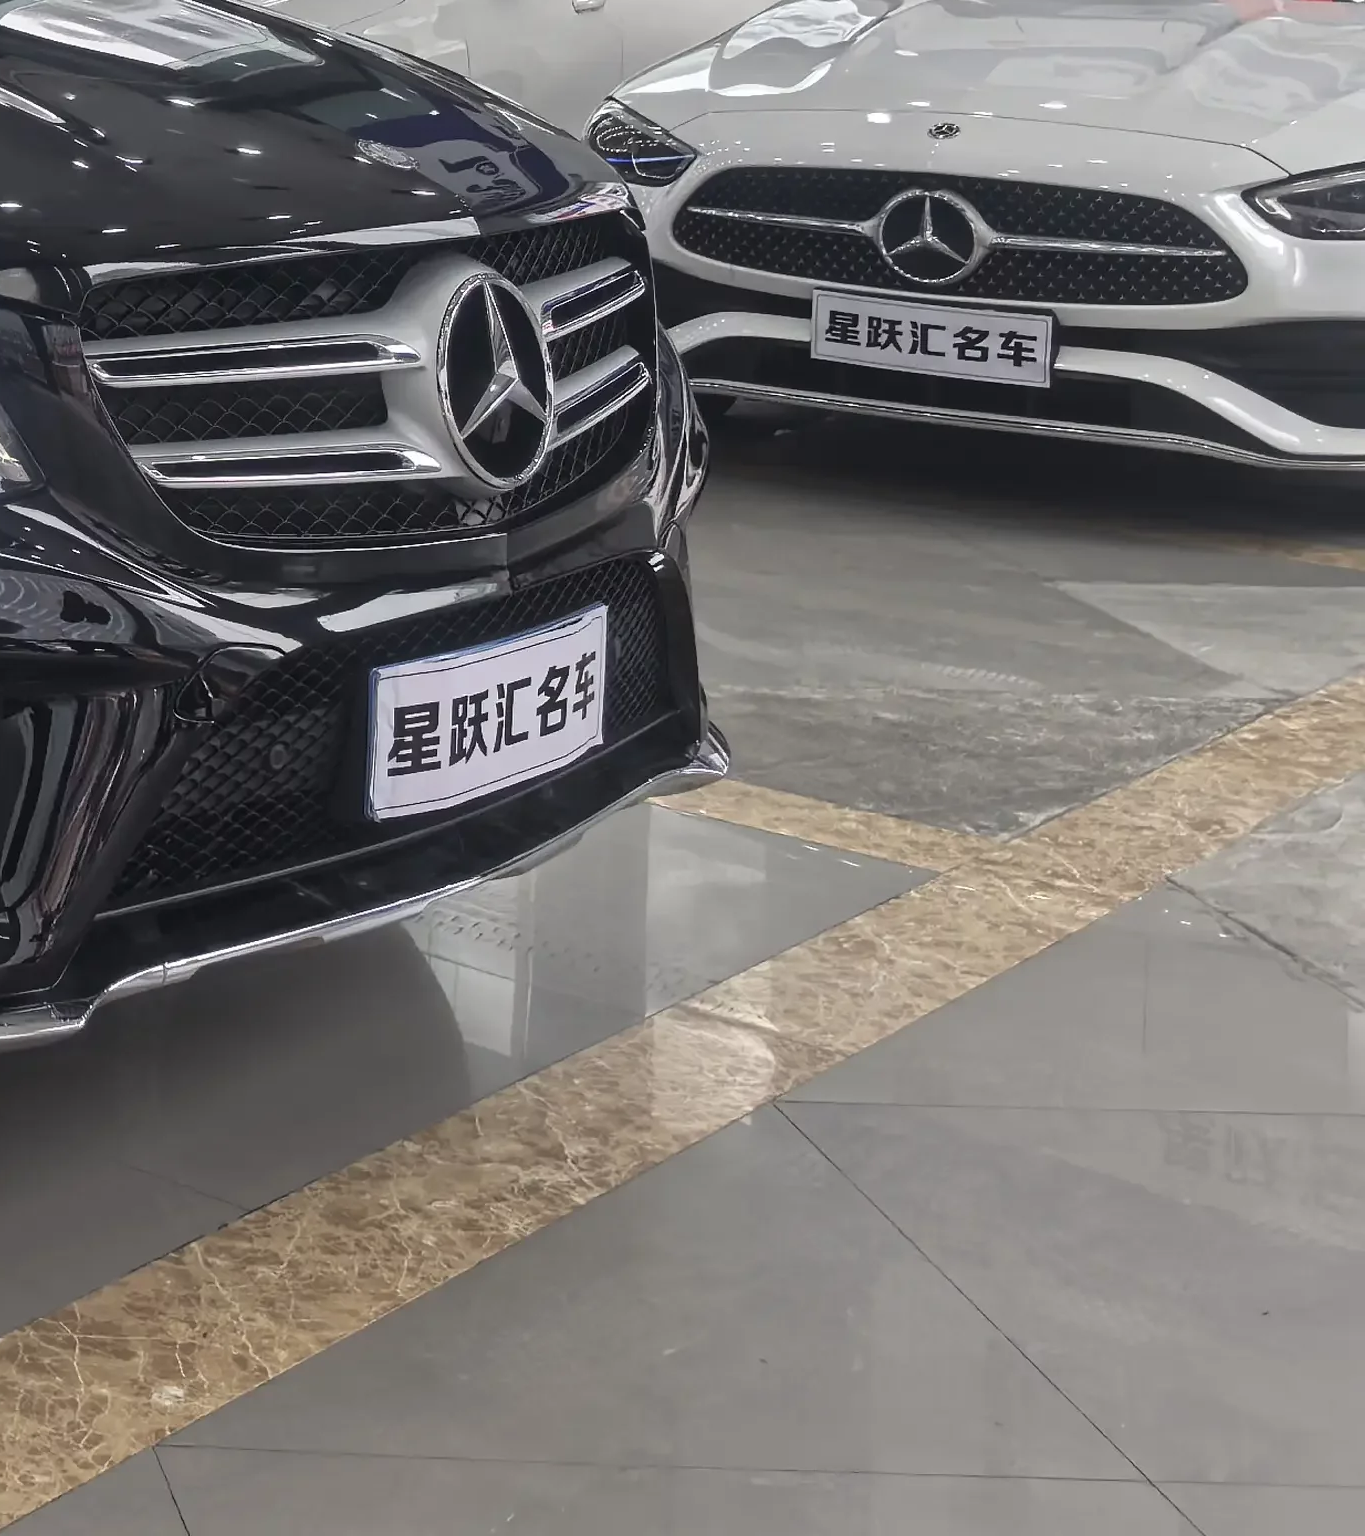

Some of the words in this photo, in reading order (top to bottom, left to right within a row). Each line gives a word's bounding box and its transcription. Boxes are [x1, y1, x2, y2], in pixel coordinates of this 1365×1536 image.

[823, 311, 1039, 369] 星跃汇名车
[387, 651, 597, 778] 星跃汇名车
